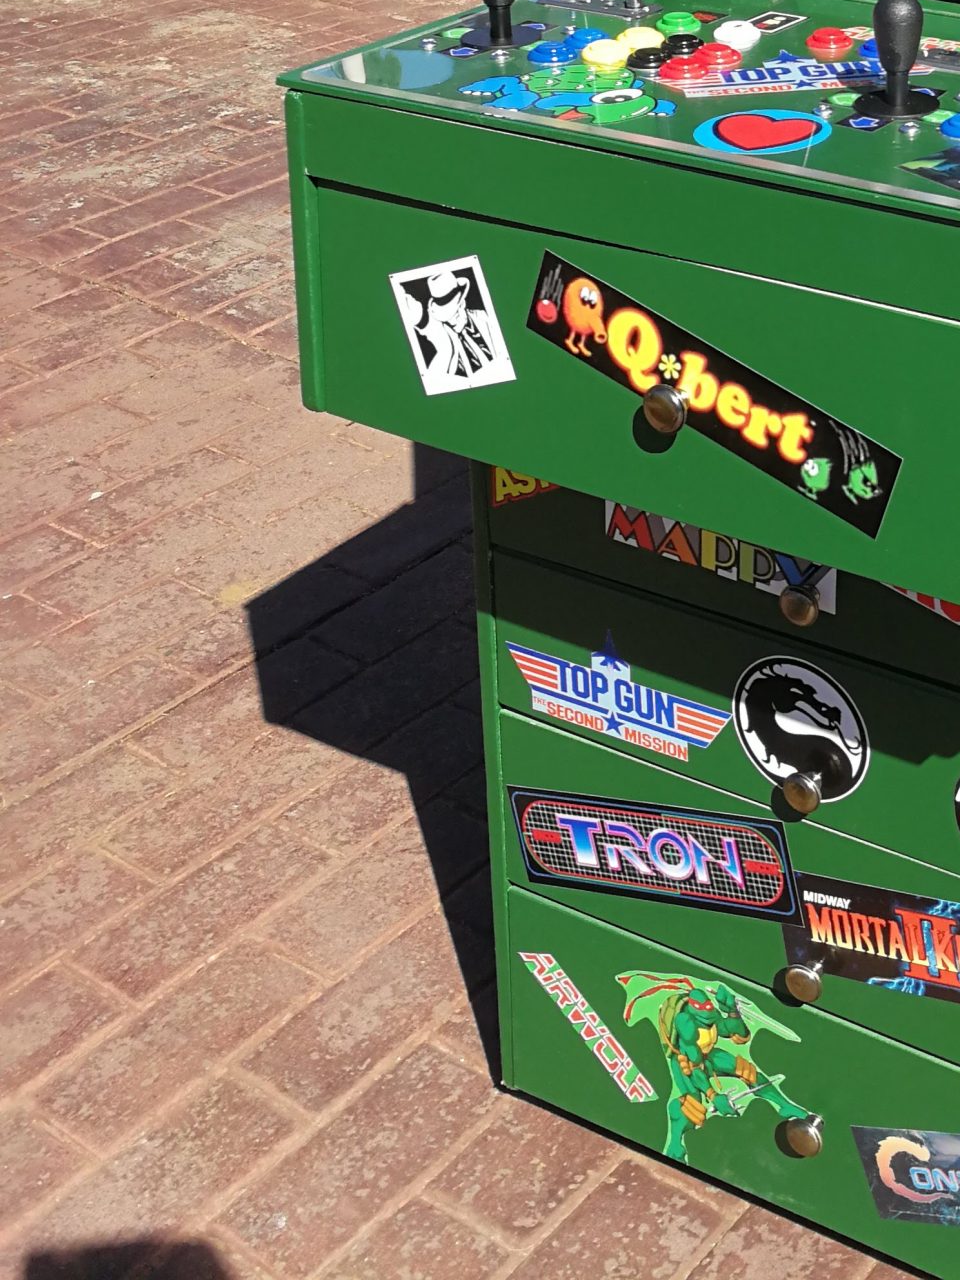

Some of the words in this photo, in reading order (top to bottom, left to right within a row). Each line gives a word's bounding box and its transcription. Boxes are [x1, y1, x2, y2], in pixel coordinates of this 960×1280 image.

[707, 84, 793, 96] SECOND
[718, 66, 793, 83] TOP
[799, 61, 883, 78] GUN
[606, 502, 826, 588] MAPPY
[532, 695, 547, 707] THE
[545, 701, 604, 732] SECOND
[624, 727, 688, 761] MISSION
[558, 662, 609, 704] TOP
[613, 678, 676, 729] GUN
[555, 814, 746, 890] TRON
[803, 889, 851, 910] MIDWAY
[804, 902, 931, 967] MORTAL
